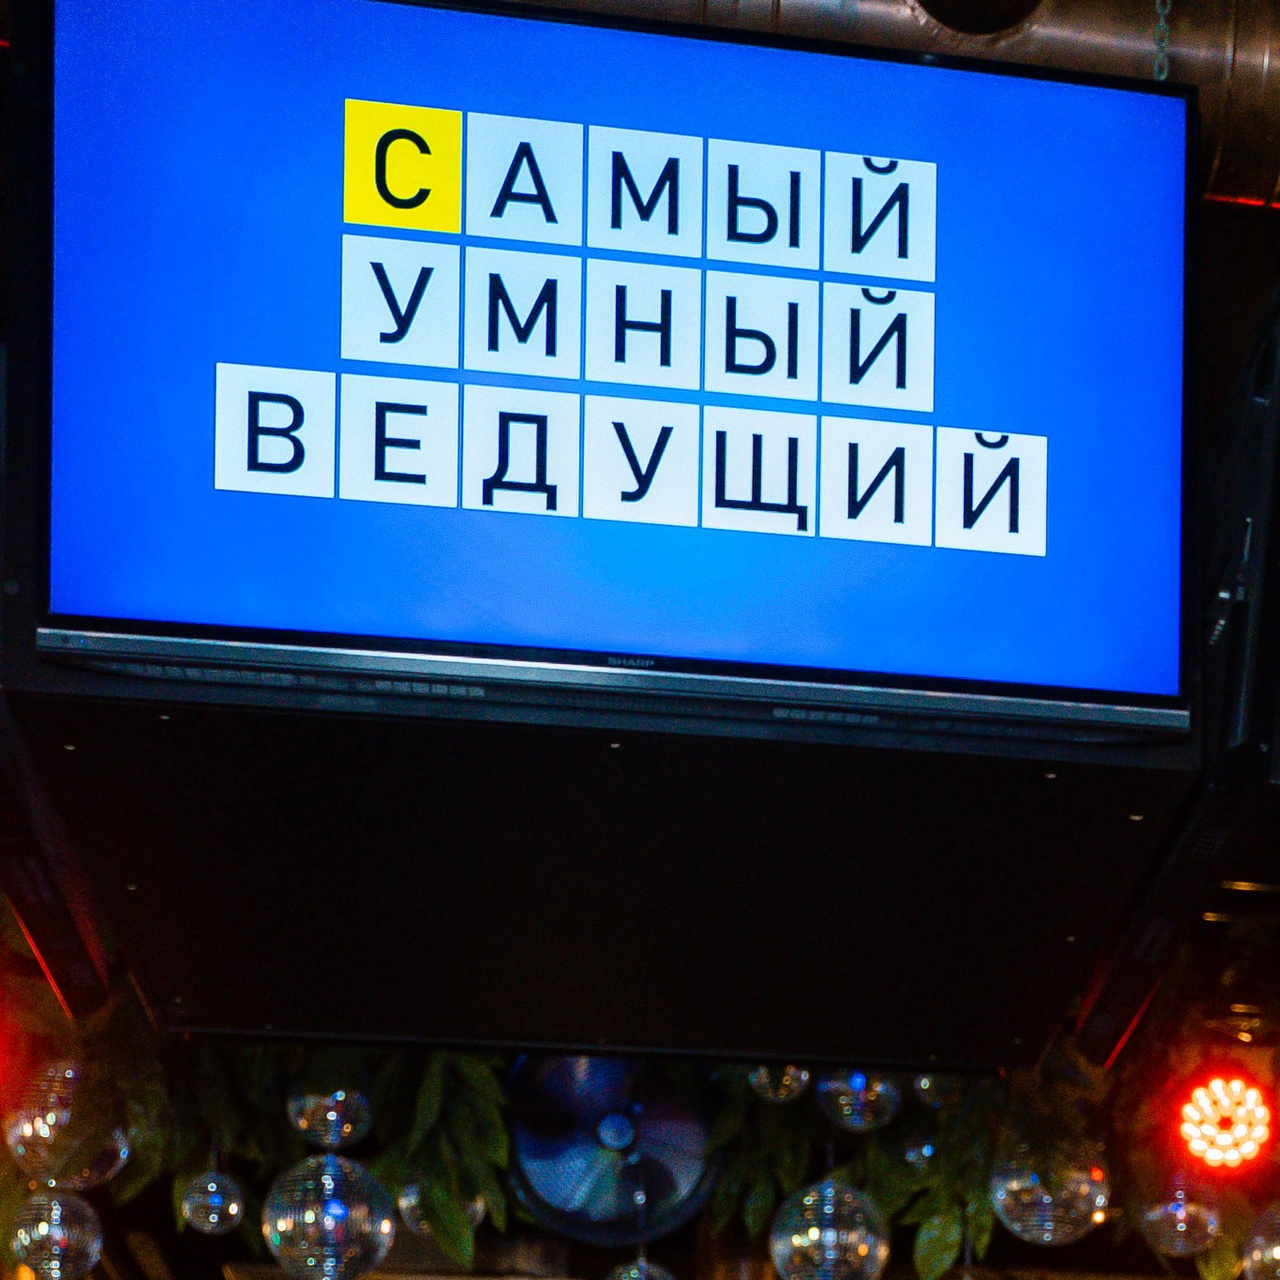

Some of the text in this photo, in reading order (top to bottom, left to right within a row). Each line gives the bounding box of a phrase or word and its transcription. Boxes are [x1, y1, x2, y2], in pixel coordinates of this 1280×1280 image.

[376, 129, 908, 258] САМЫЙ
[372, 264, 907, 388] УМНЫЙ
[247, 393, 1019, 533] ВЕДУЩИЙ
[607, 657, 655, 668] SHARP
